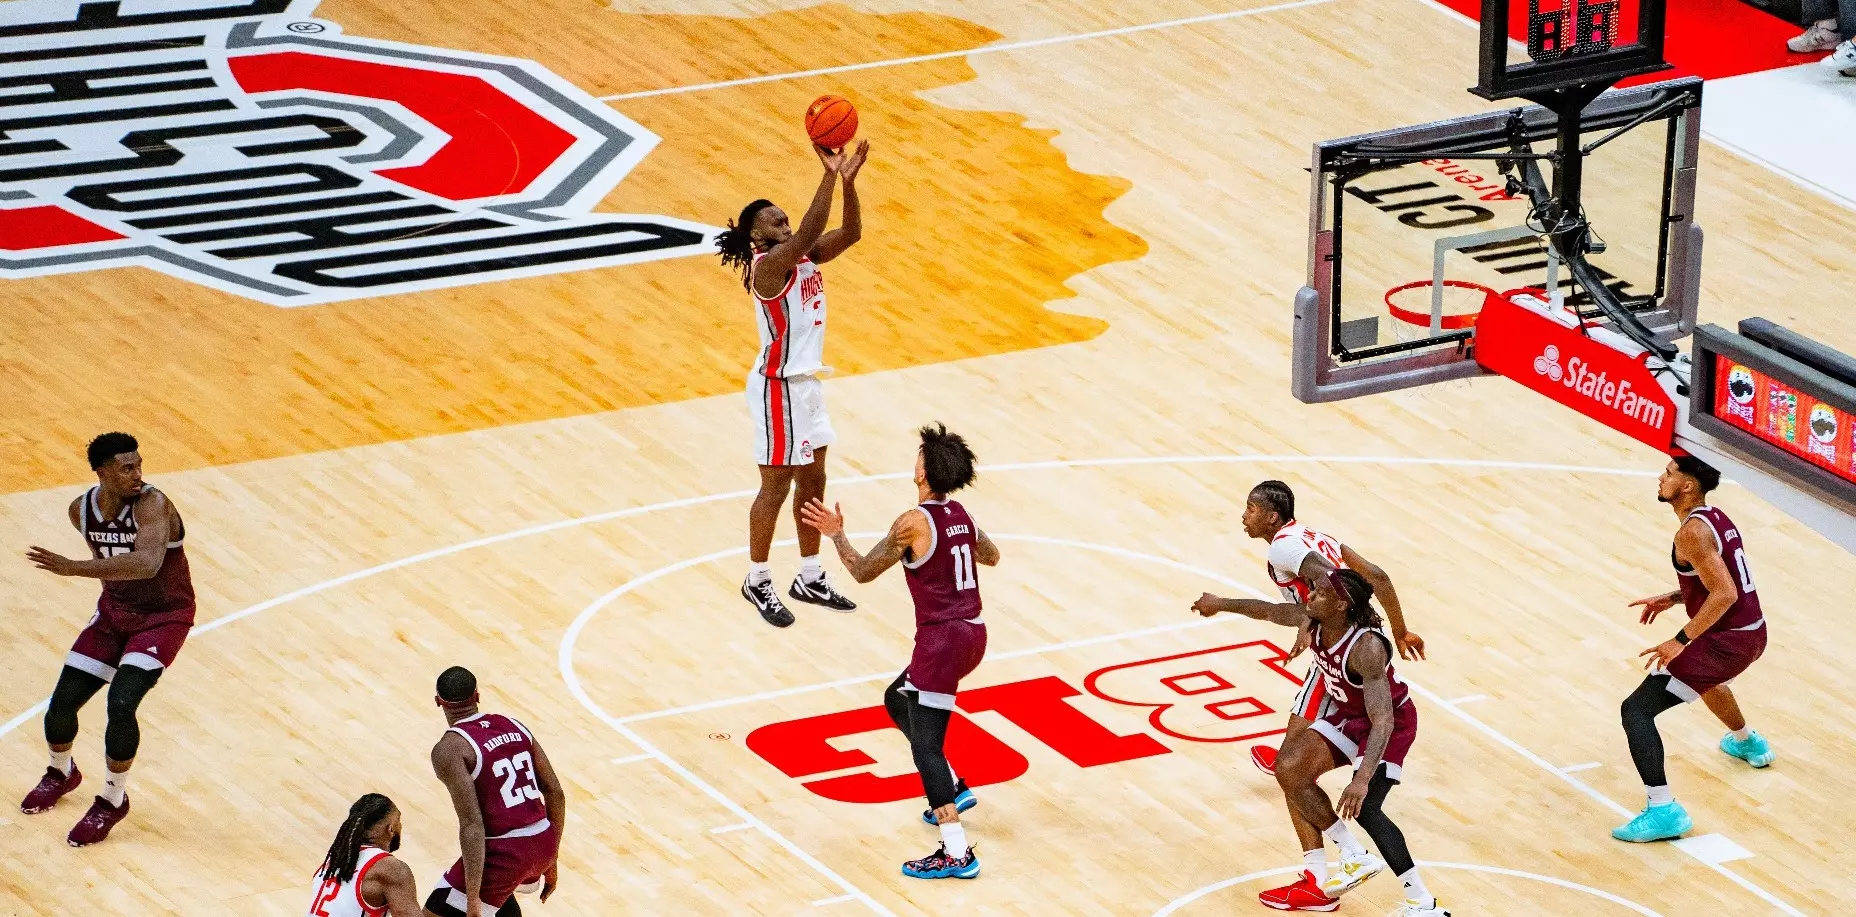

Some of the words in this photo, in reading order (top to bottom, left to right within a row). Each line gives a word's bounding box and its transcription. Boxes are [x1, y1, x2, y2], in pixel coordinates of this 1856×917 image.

[88, 531, 119, 543] TEXAS
[945, 524, 969, 537] GARCIA
[950, 543, 976, 591] 11
[483, 732, 522, 752] RADFORD
[492, 750, 541, 809] 23
[310, 876, 341, 917] 12
